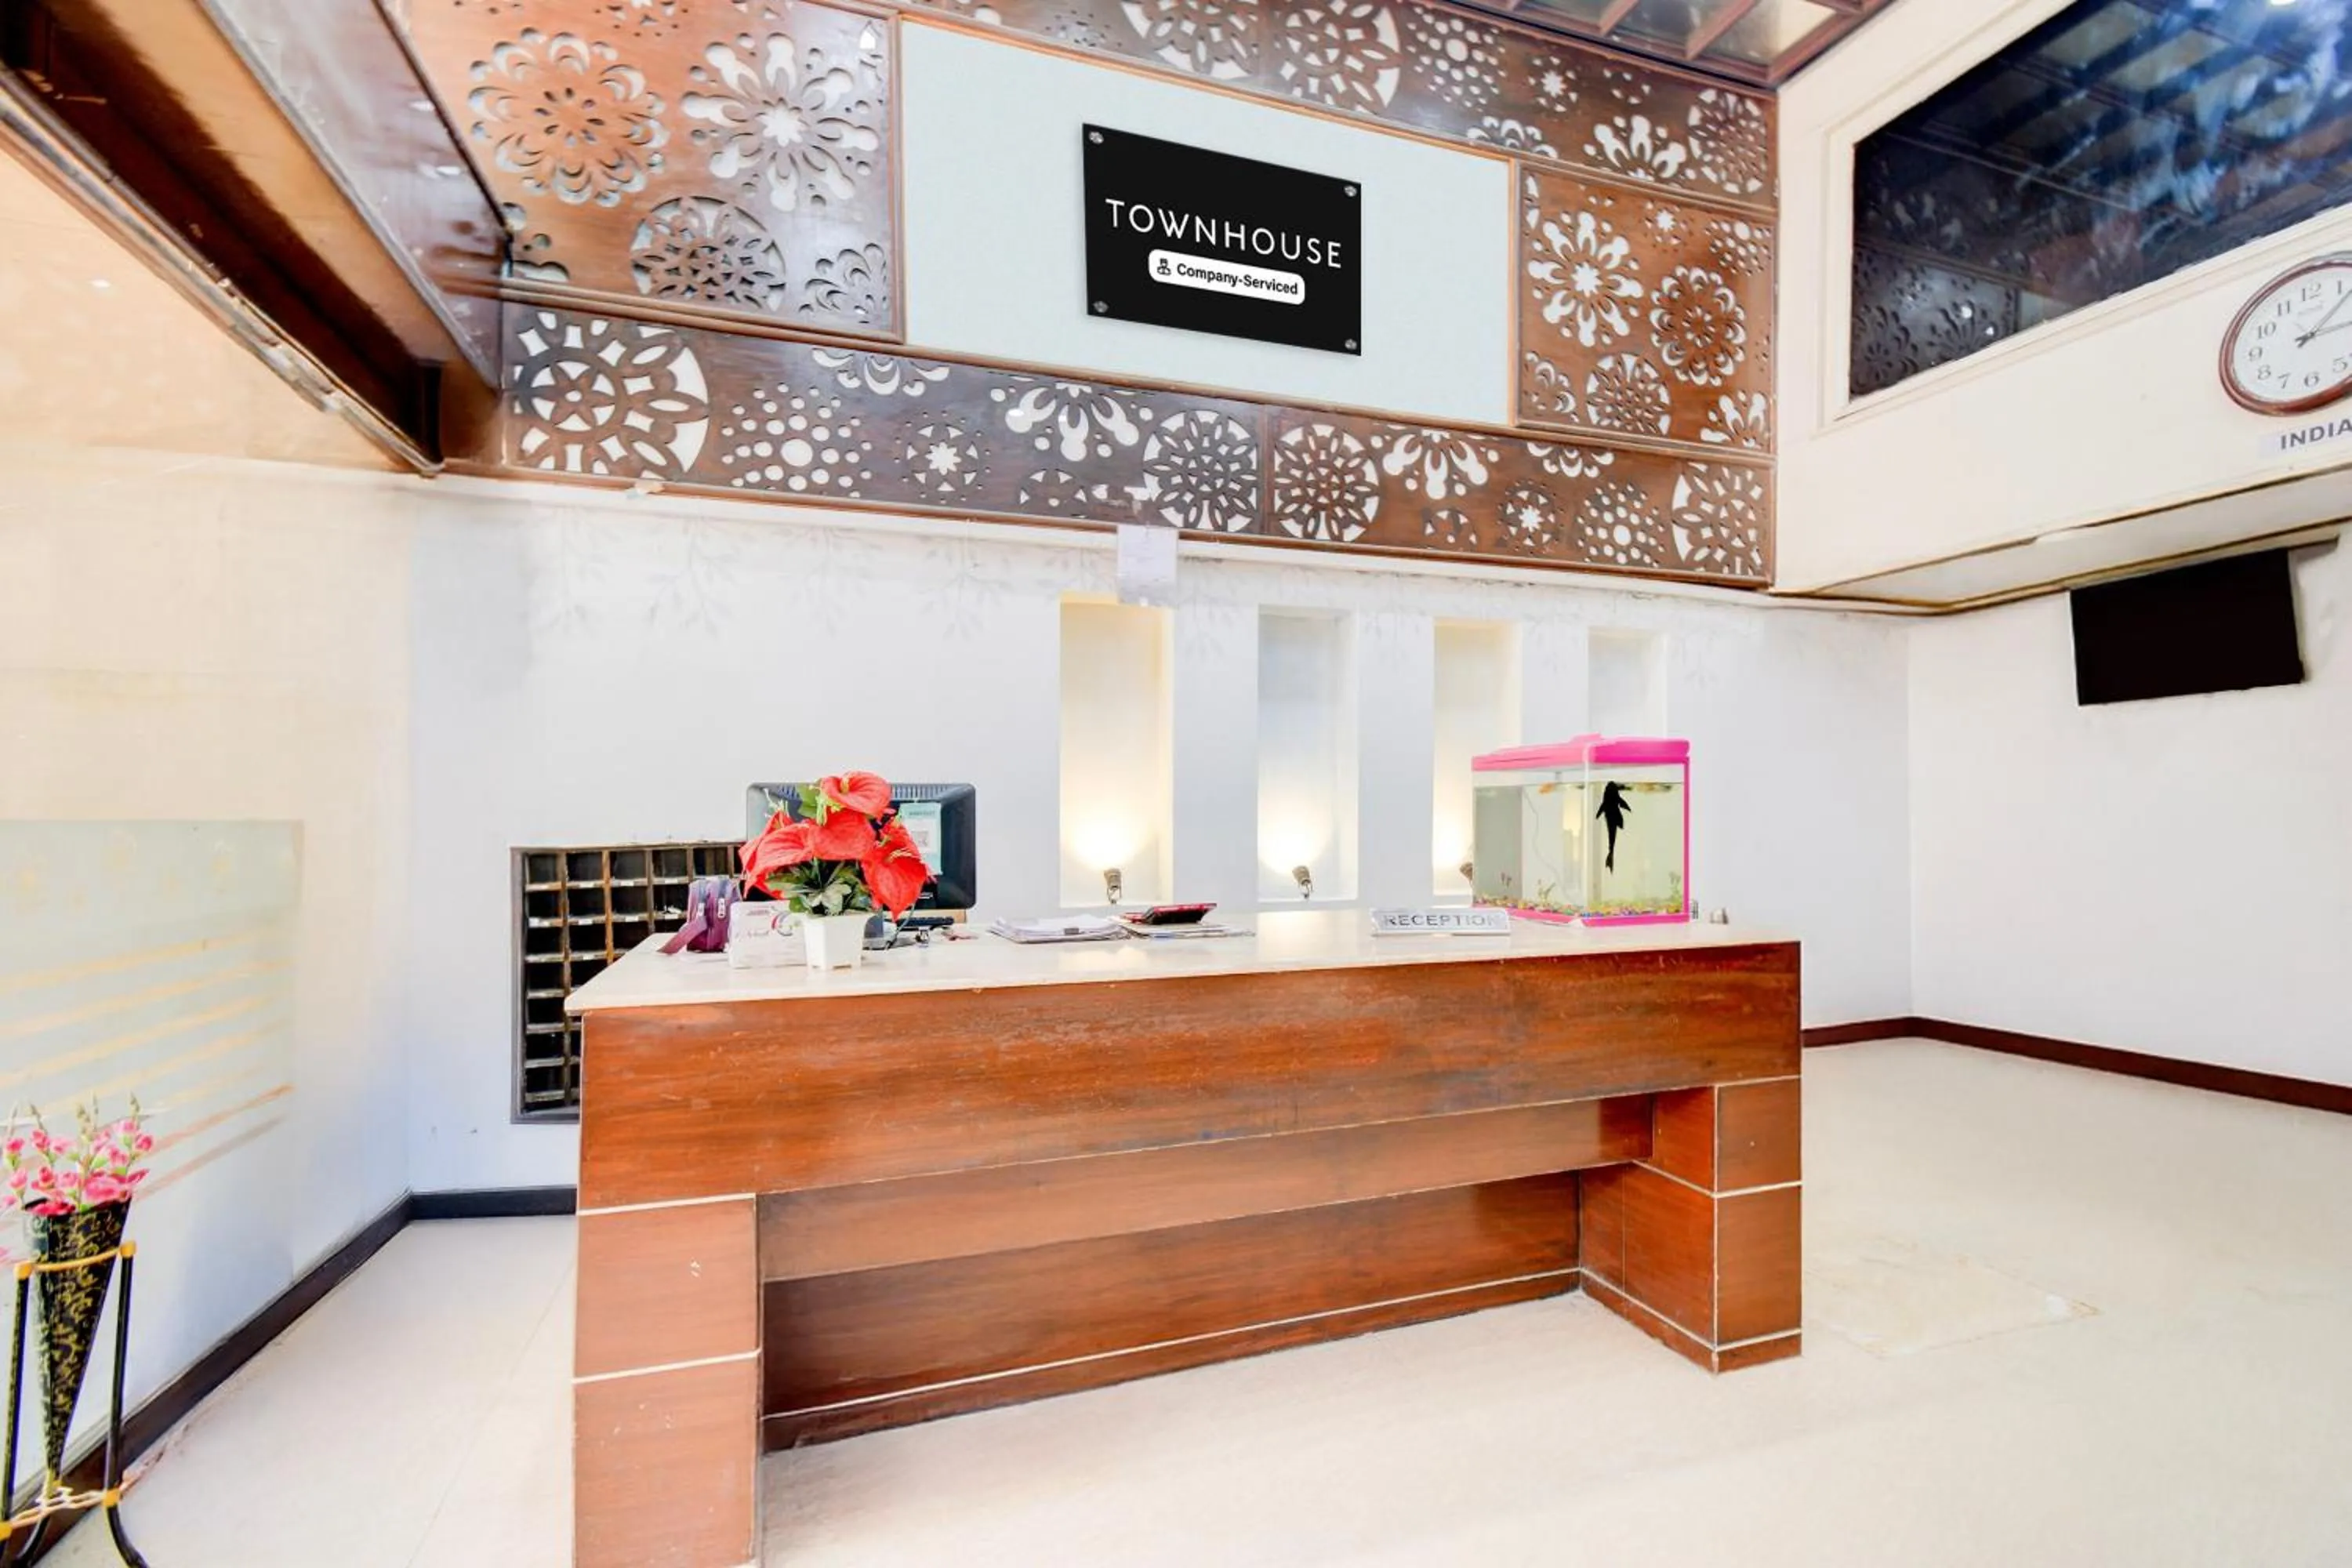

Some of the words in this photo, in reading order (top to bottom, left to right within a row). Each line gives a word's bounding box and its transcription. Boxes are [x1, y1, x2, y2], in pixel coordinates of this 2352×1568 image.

[1105, 198, 1341, 269] TOWNHOUSE
[1176, 263, 1298, 296] Company-Serviced
[2281, 419, 2352, 450] INDIA
